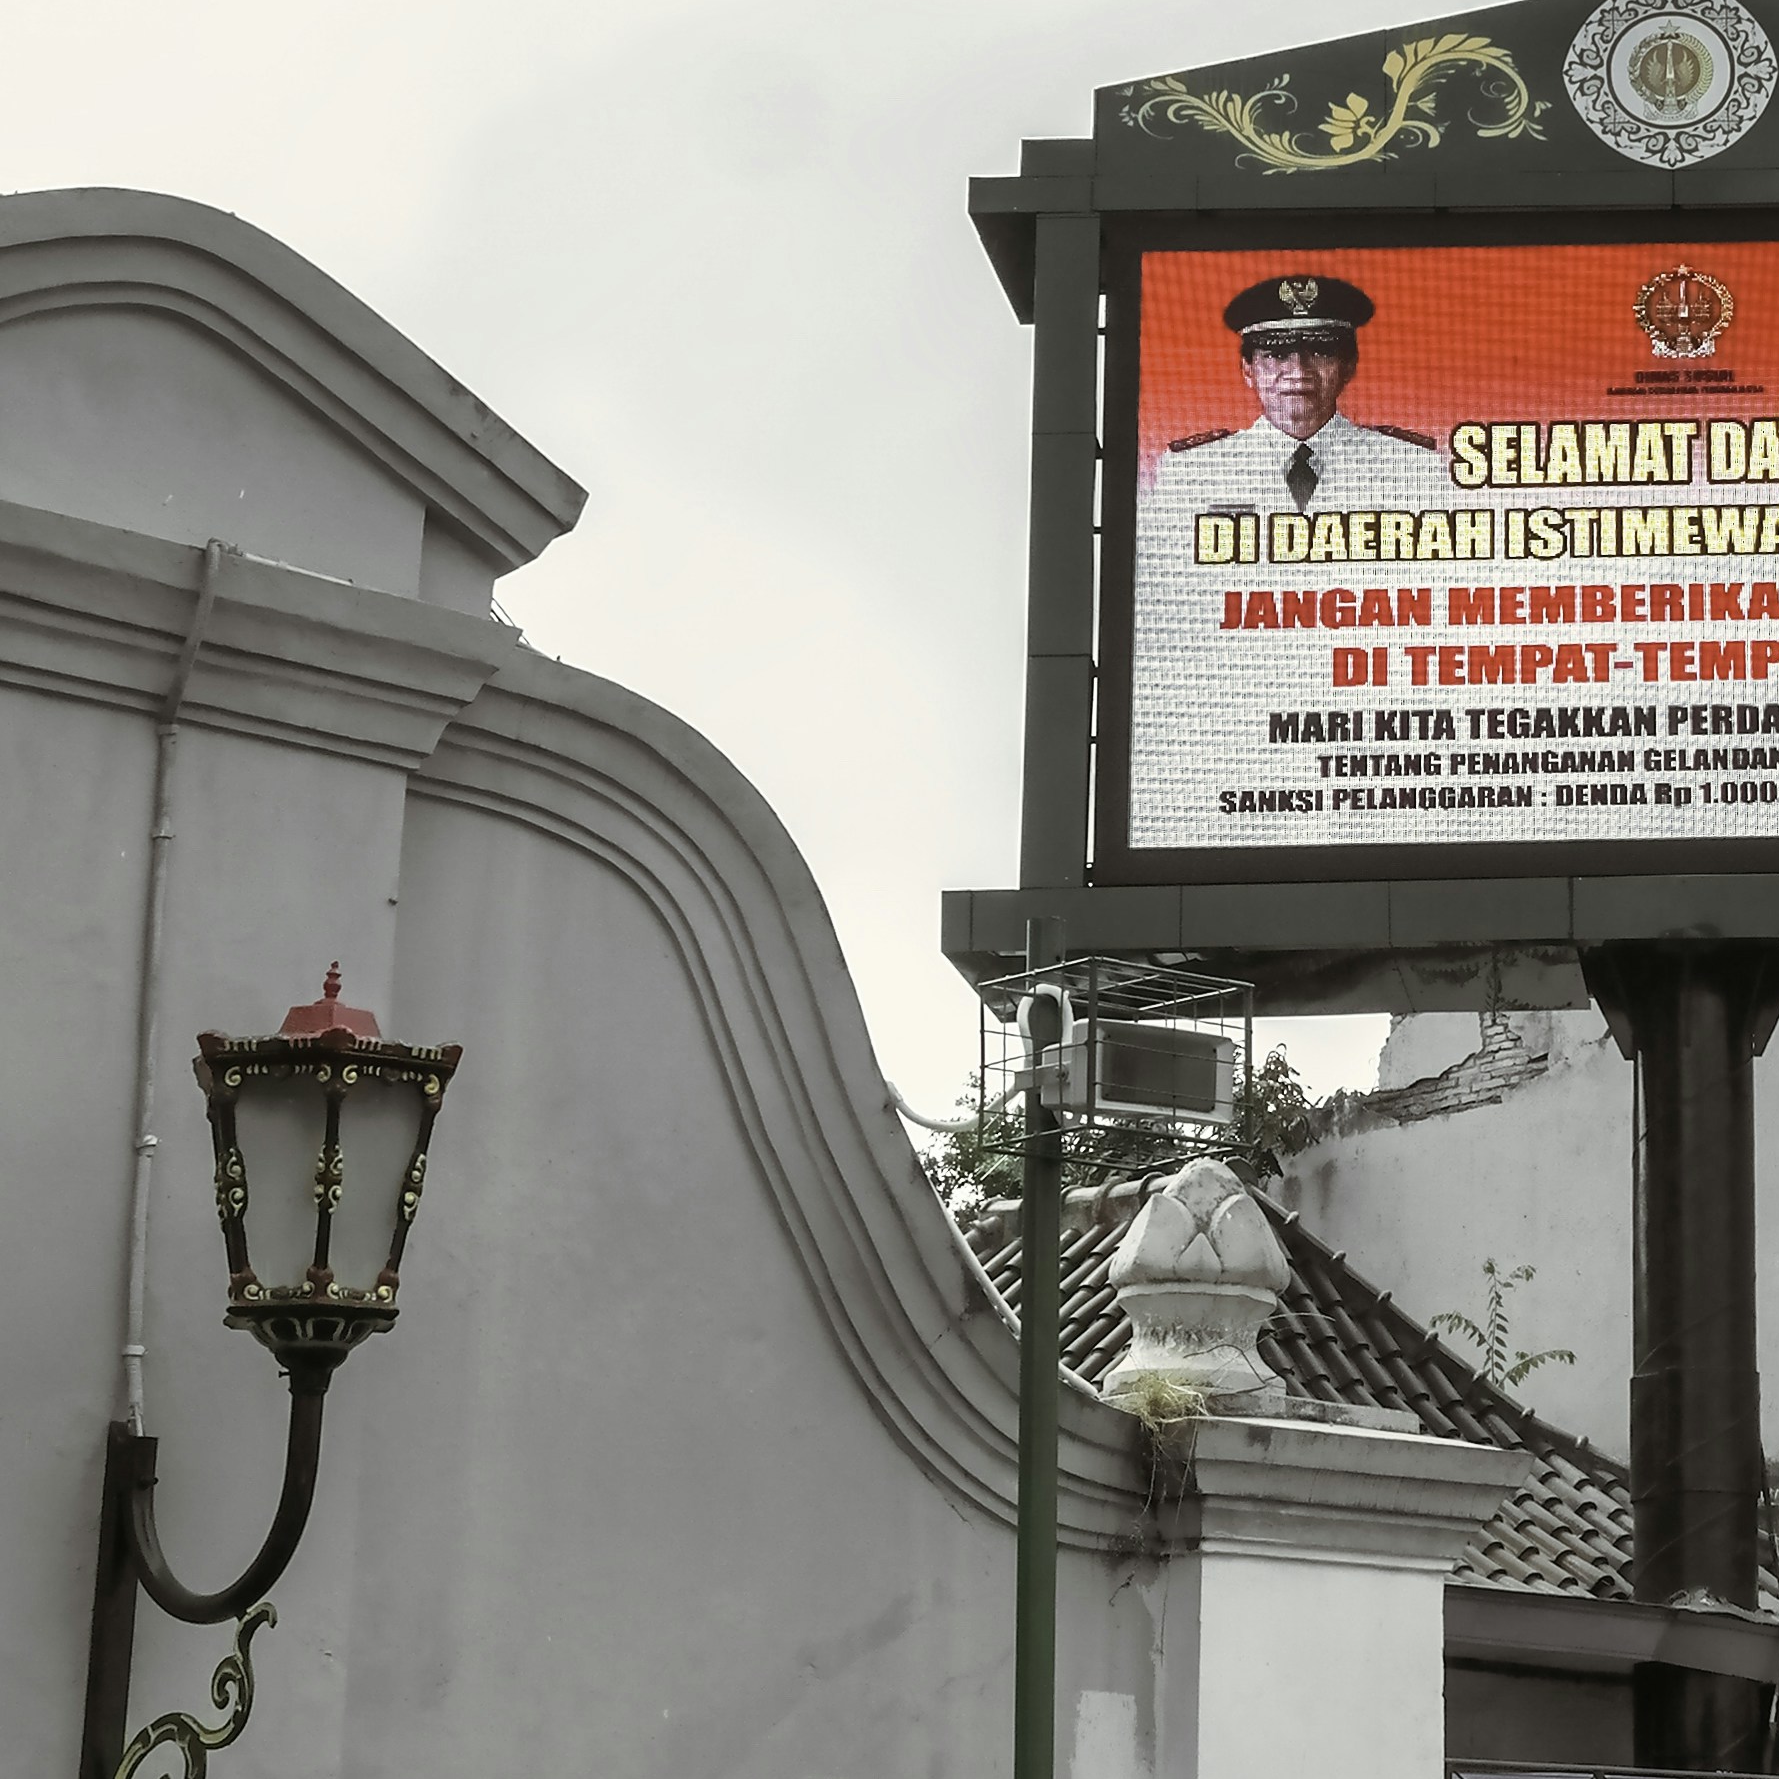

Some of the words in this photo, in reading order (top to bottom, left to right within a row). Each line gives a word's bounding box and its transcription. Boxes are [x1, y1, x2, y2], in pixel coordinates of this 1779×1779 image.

[1450, 419, 1698, 488] SELAMAT
[1195, 511, 1259, 564] DI
[1268, 509, 1495, 563] DAERAH
[1220, 587, 1433, 630] JANGAN
[1332, 646, 1389, 687] DI
[1268, 710, 1364, 744] MARI
[1374, 708, 1456, 742] KITA
[1465, 705, 1658, 741] TEGAKKAN
[1317, 752, 1442, 778] TENTANG
[1450, 750, 1636, 777] PENANGANAN
[1217, 788, 1324, 815] SANKSI
[1331, 784, 1534, 812] PELANGGARAN
[1554, 782, 1649, 808] DENDA
[1655, 782, 1692, 808] Rp
